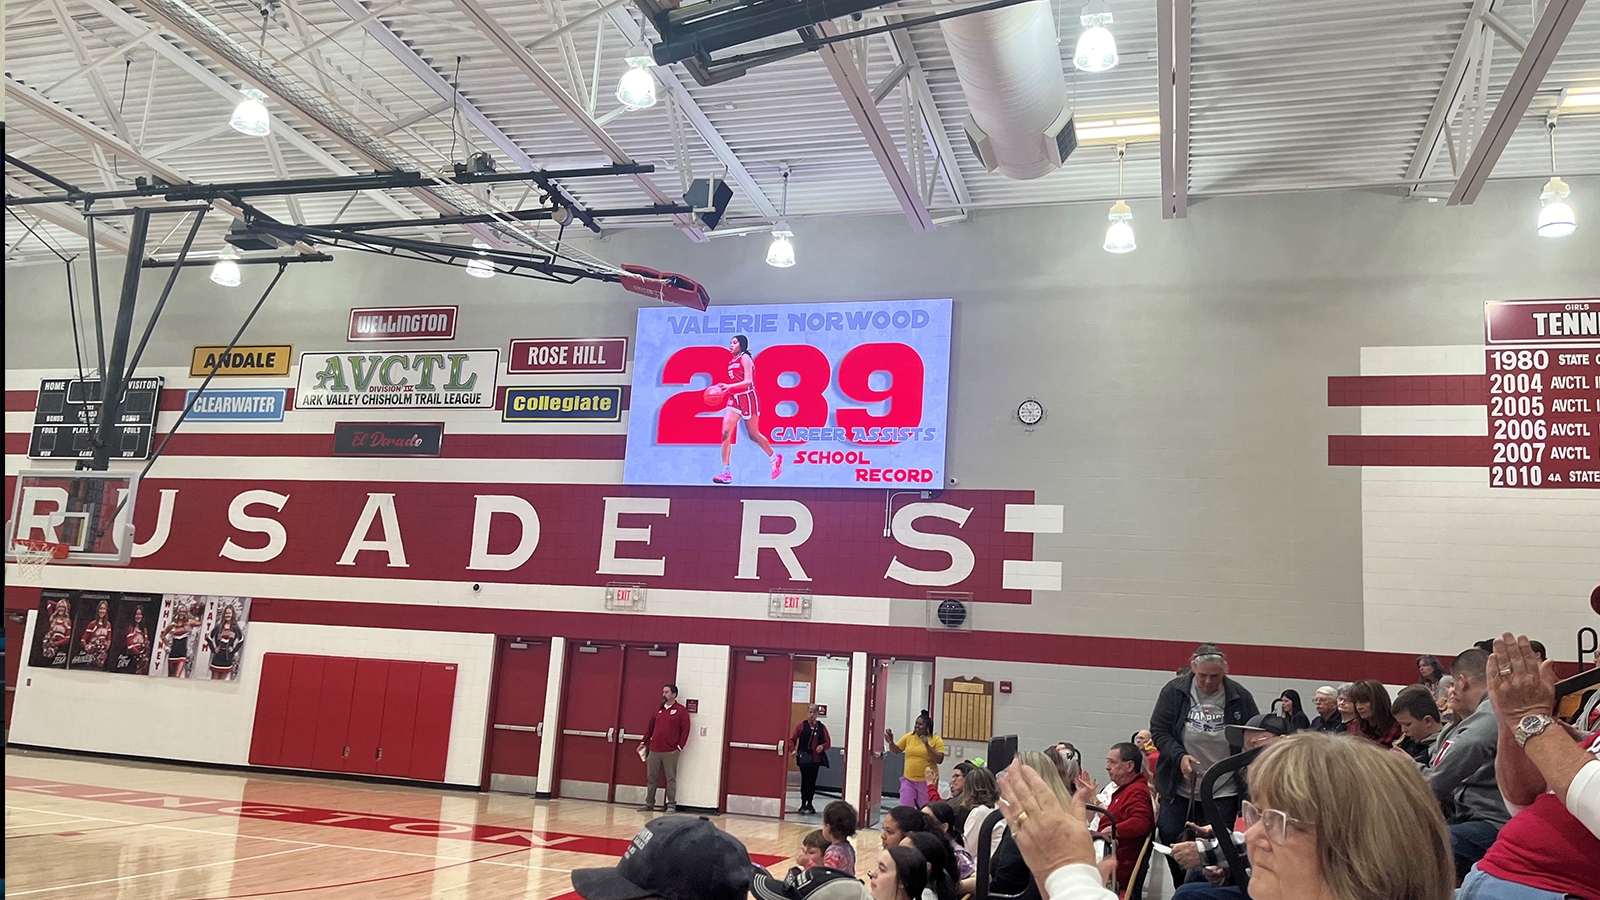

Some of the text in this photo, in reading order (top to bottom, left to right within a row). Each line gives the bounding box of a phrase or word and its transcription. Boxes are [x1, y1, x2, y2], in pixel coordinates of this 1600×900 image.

[357, 313, 448, 334] WELLINGTON
[667, 309, 930, 335] VALERIE NORWOOD
[1532, 312, 1600, 336] TENN
[203, 352, 276, 369] ANDALE
[528, 345, 606, 365] ROSE HILL
[1490, 350, 1549, 371] 1980
[1558, 354, 1590, 365] STATE
[312, 353, 478, 392] AVCTL
[44, 382, 66, 391] HOME
[128, 380, 157, 390] VISITOR
[369, 385, 401, 393] DIVISION
[1490, 373, 1543, 394] 2004
[1550, 376, 1590, 389] AVCTL
[302, 392, 482, 406] ARK VALLEY CHISHOLM TRAIL LEAGUE
[656, 342, 925, 445] 289
[193, 396, 276, 413] CLEARWATER
[512, 395, 612, 412] Collegiate
[1491, 396, 1545, 417] 2005
[1551, 399, 1592, 412] AVCTL
[770, 427, 936, 443] CAREER ASSISTS
[1494, 419, 1591, 440] 2006 AVCTL
[352, 431, 423, 448] El Dorado
[793, 451, 871, 465] SCHOOL
[1492, 442, 1591, 463] 2007 AVCTL
[855, 469, 934, 483] RECORD
[1492, 466, 1600, 486] 2010 4A STATE
[617, 589, 631, 601] EXIT
[784, 596, 800, 609] EXIT
[154, 600, 172, 670] WHINEY
